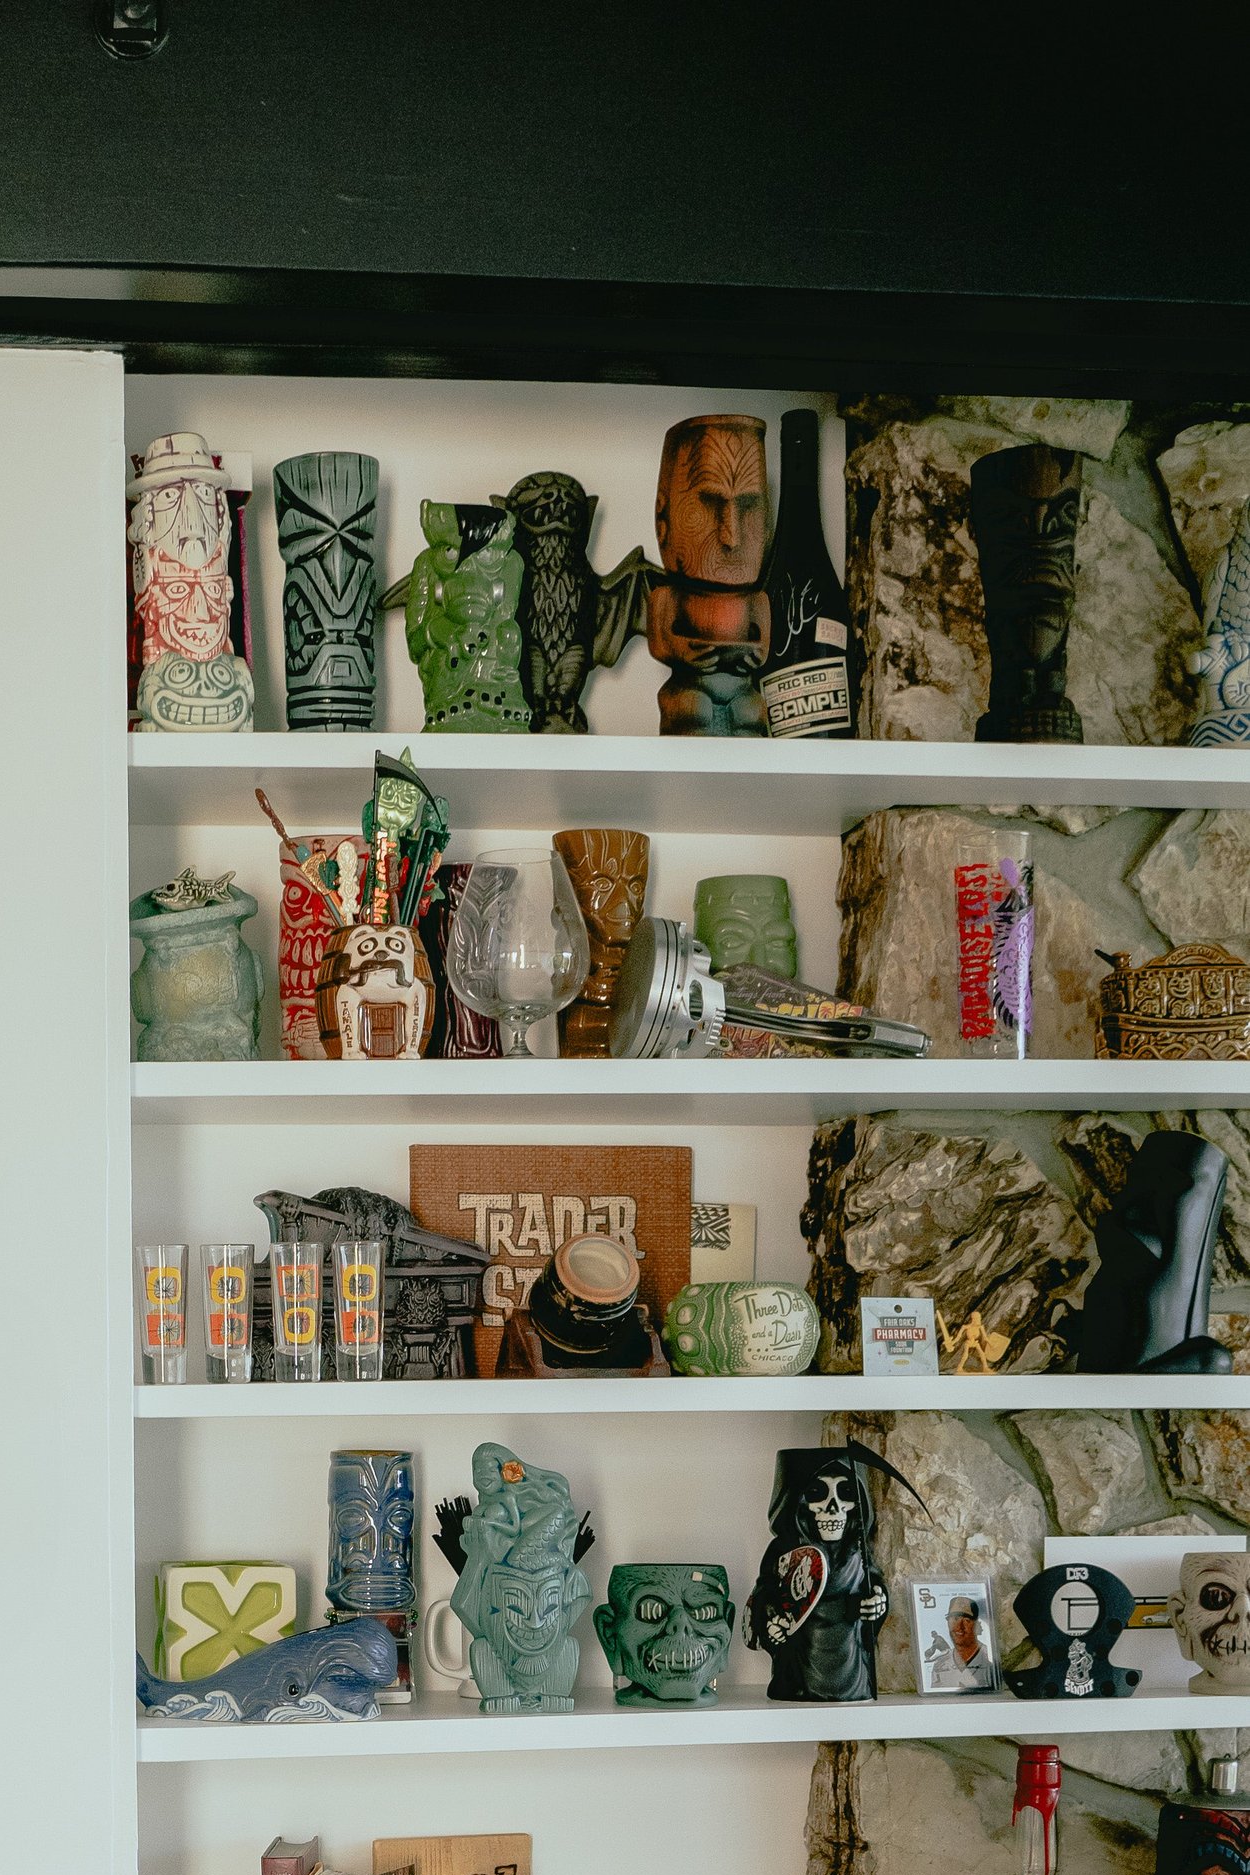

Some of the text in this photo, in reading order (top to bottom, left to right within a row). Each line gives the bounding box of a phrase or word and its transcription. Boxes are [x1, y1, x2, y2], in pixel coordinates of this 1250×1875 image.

[777, 678, 801, 693] RIC
[803, 672, 827, 686] RED
[769, 690, 847, 723] SAMPLE
[457, 1192, 645, 1259] TRADER
[733, 1290, 807, 1325] Three Dots
[751, 1325, 767, 1339] and
[770, 1319, 802, 1347] Dash
[883, 1318, 915, 1327] FAIR OAKS
[876, 1329, 924, 1340] PHARMACY
[751, 1353, 794, 1362] CHICAGO
[1066, 1567, 1089, 1581] DF3
[919, 1587, 937, 1609] SD
